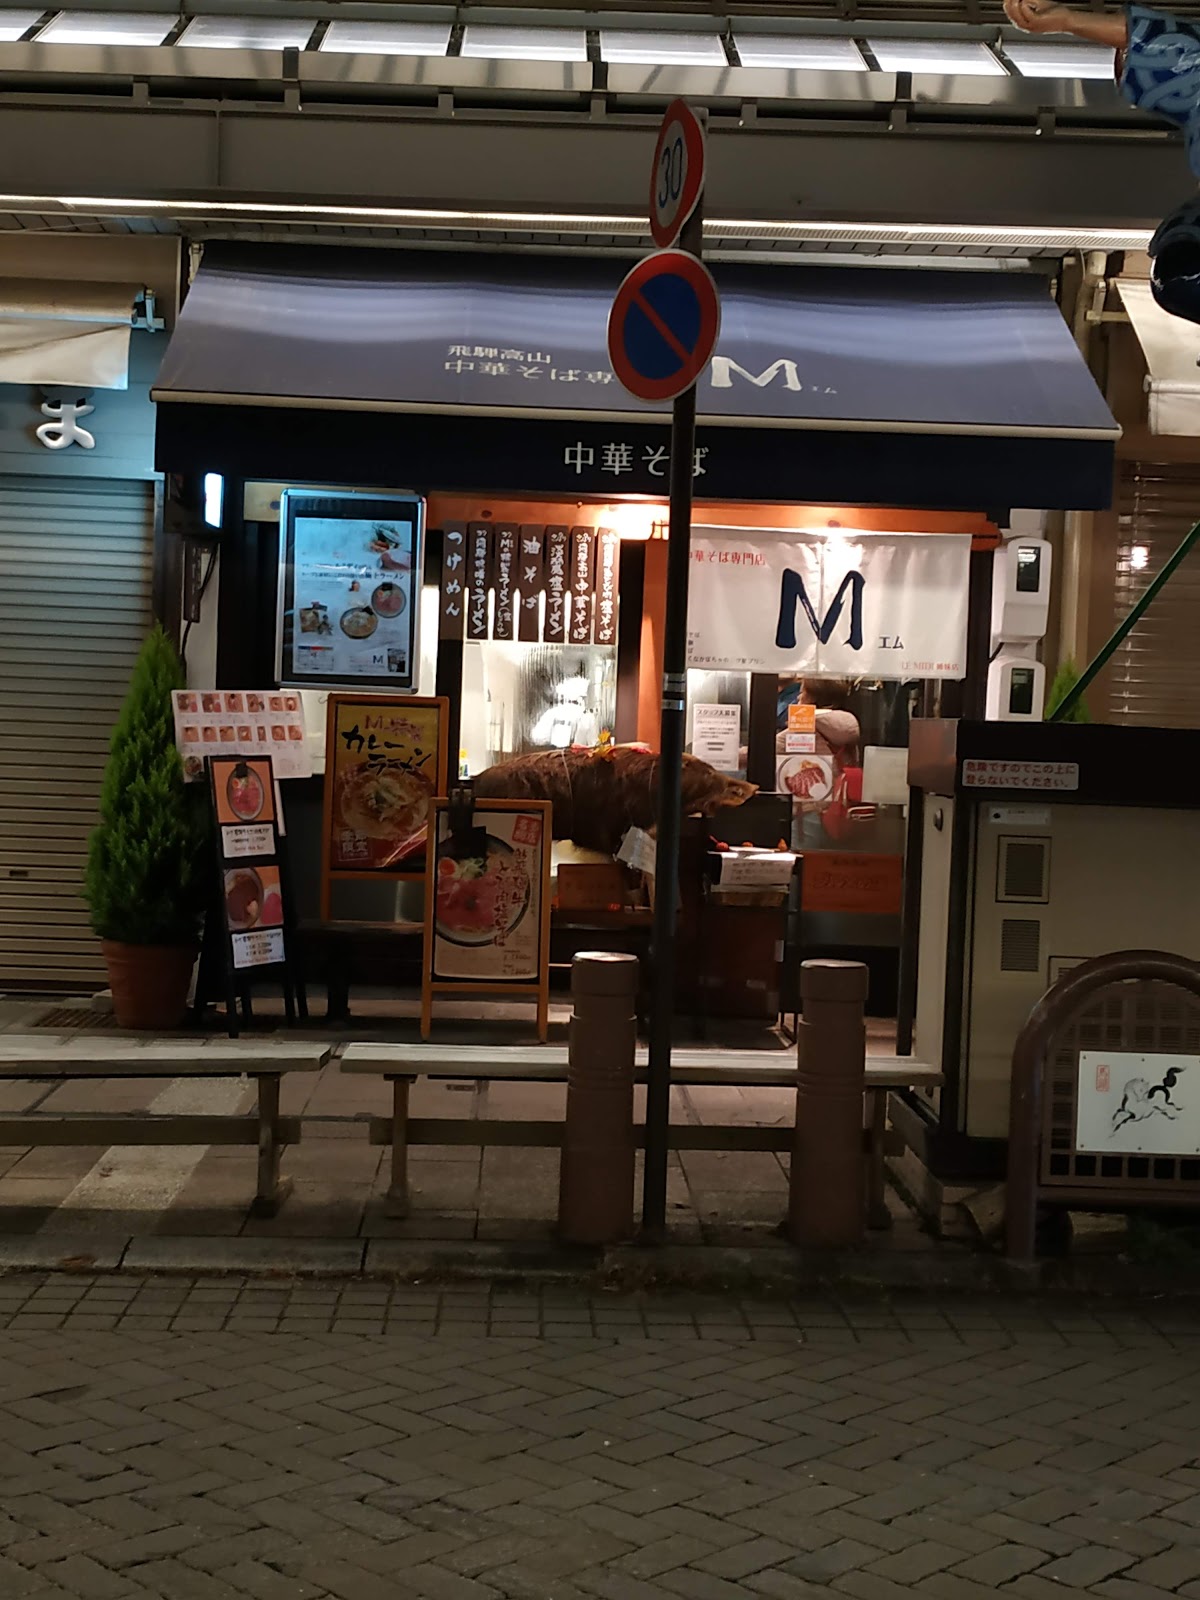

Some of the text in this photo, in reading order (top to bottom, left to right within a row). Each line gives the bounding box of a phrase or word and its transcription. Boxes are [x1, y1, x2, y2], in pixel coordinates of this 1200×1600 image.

[658, 136, 683, 209] 30
[447, 344, 551, 365] 飛騨高山
[710, 355, 802, 392] M
[445, 531, 463, 617] つけめん
[521, 536, 541, 610] 油そば
[775, 567, 866, 651] M
[877, 635, 905, 651] エム
[341, 724, 405, 754] カレー
[367, 747, 432, 776] ラーメン
[965, 761, 1077, 775] 危険ですのでこの上に
